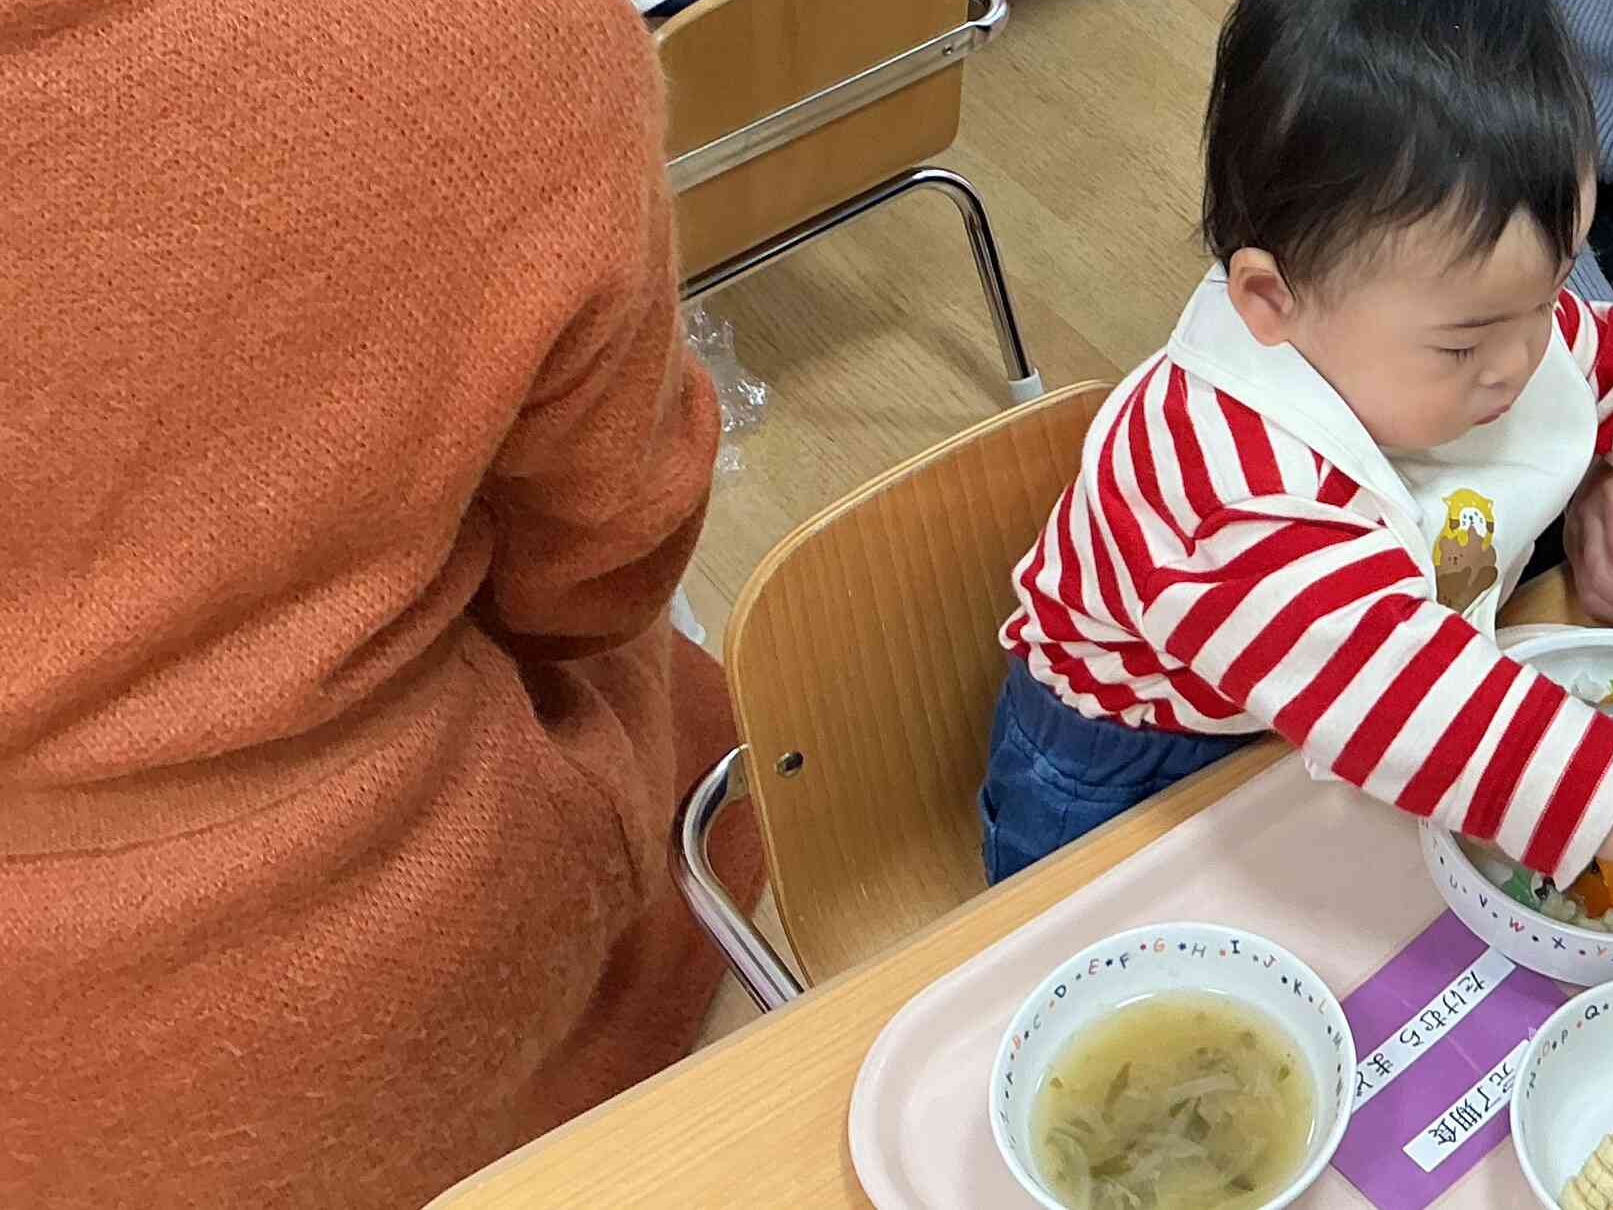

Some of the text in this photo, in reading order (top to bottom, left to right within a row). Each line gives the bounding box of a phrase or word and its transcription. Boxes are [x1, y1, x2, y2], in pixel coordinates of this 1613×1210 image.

[1399, 970, 1486, 1047] たけむら
[1427, 1062, 1516, 1146] 完了期食
